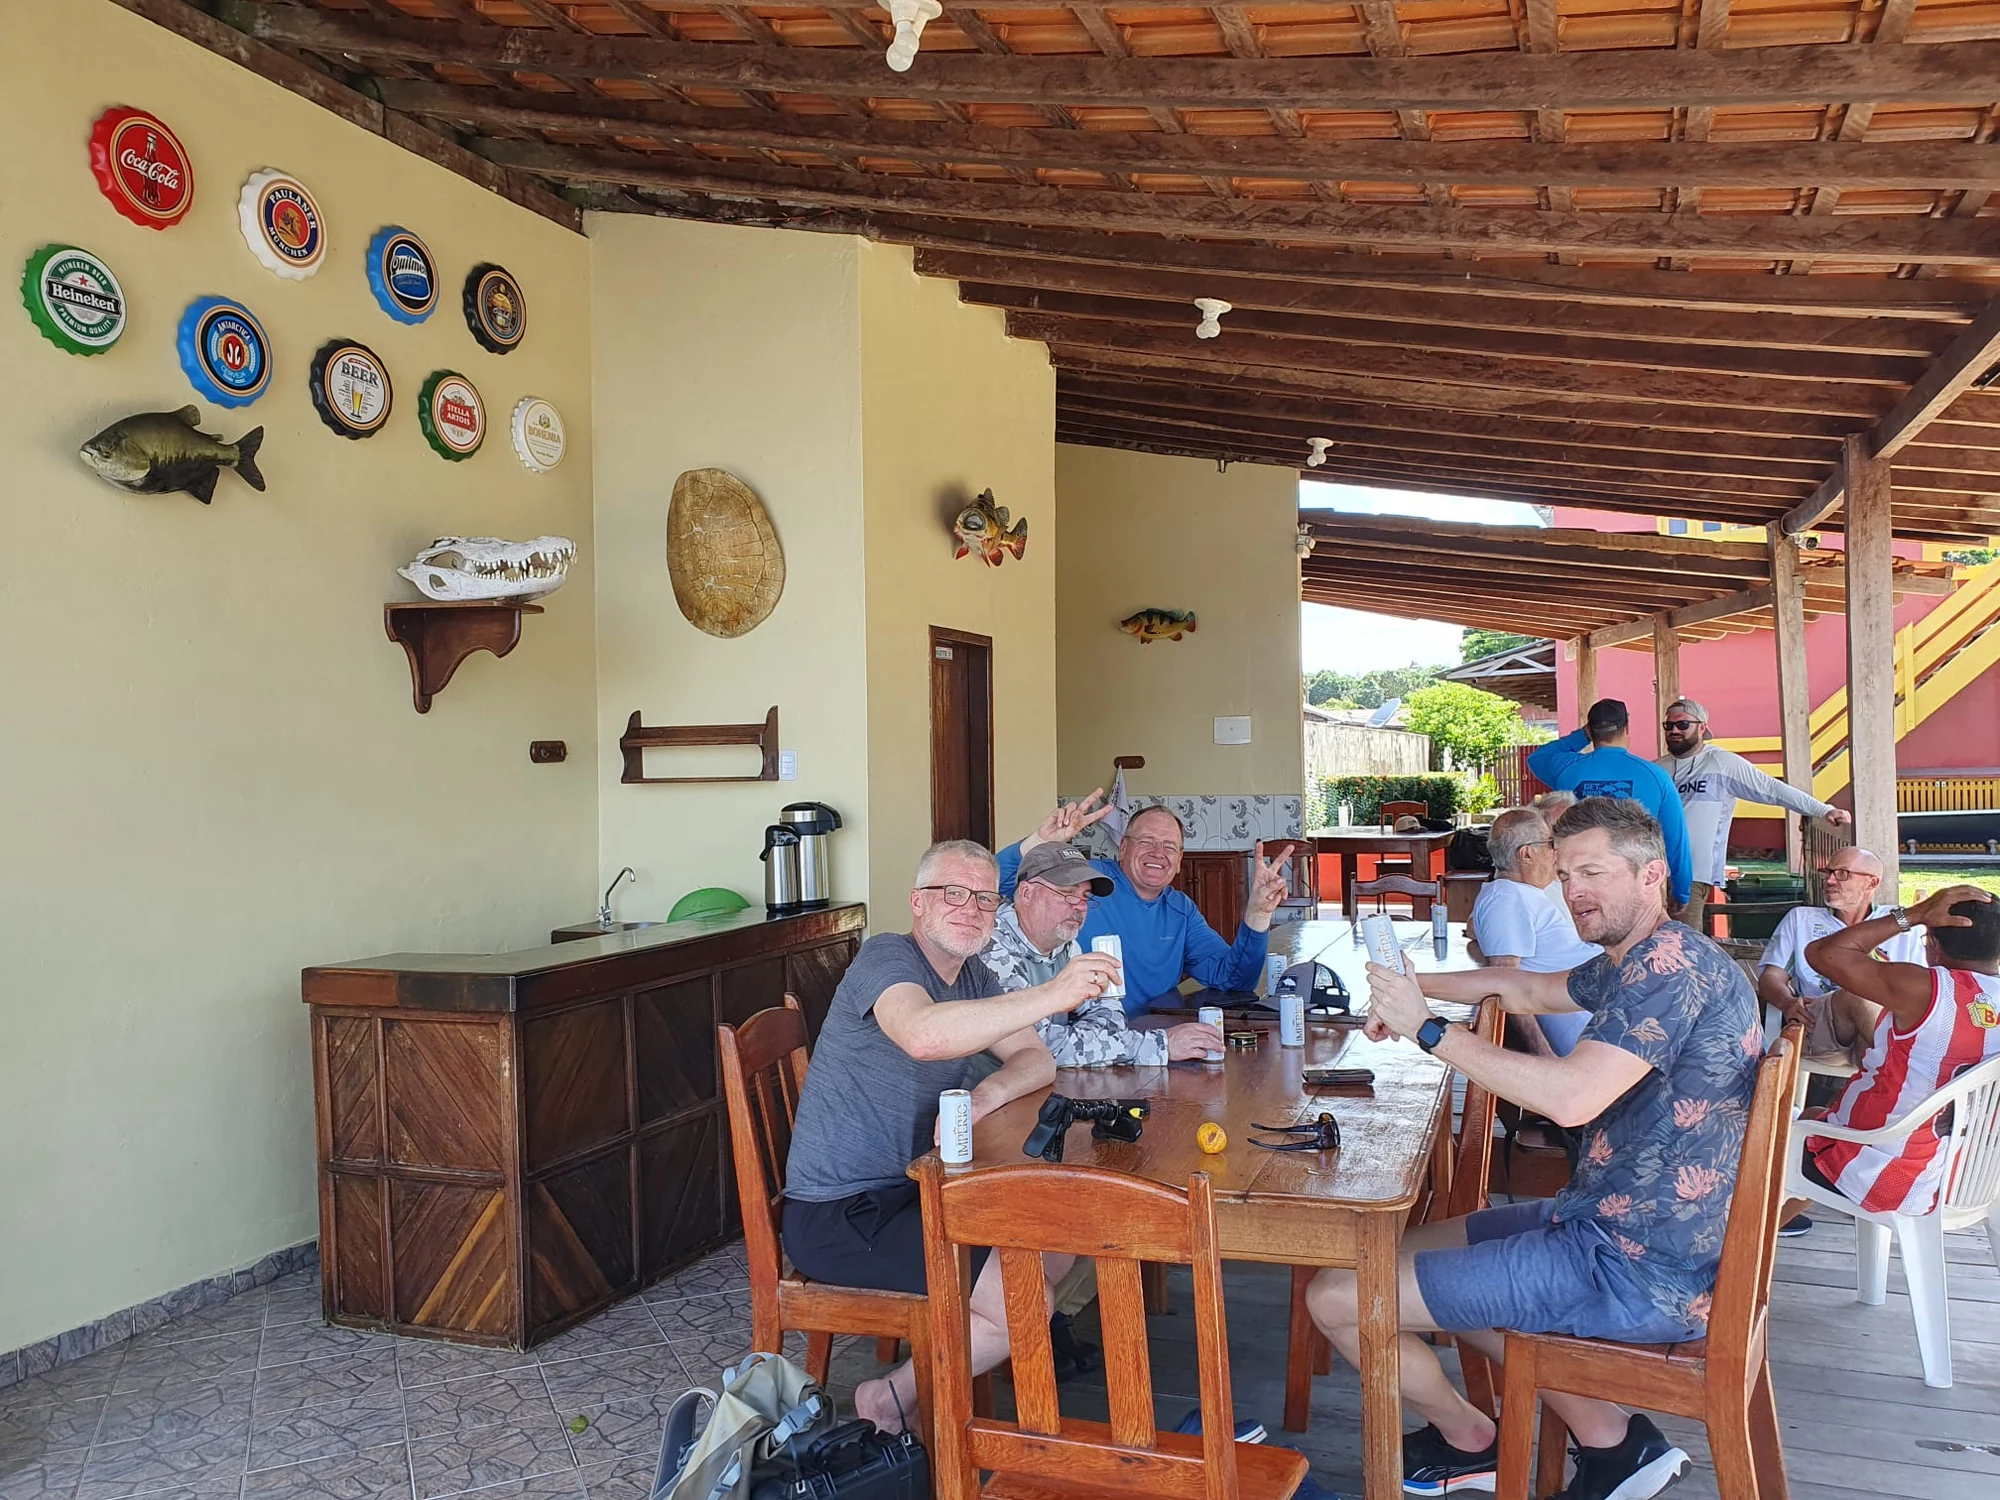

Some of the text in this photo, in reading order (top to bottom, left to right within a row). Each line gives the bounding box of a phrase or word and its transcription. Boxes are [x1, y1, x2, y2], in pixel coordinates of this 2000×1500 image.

[269, 189, 317, 230] PAULANER
[58, 260, 90, 274] HEINEKEN
[91, 266, 108, 286] BEER
[51, 283, 117, 312] Heineken
[58, 306, 88, 333] PREMIUM
[88, 319, 112, 335] QUALITY
[216, 320, 251, 344] ANTARCTICA
[341, 361, 380, 387] BEER
[446, 403, 470, 418] STELLA
[446, 411, 471, 427] ARTOIS
[527, 424, 562, 444] BOHEMIA
